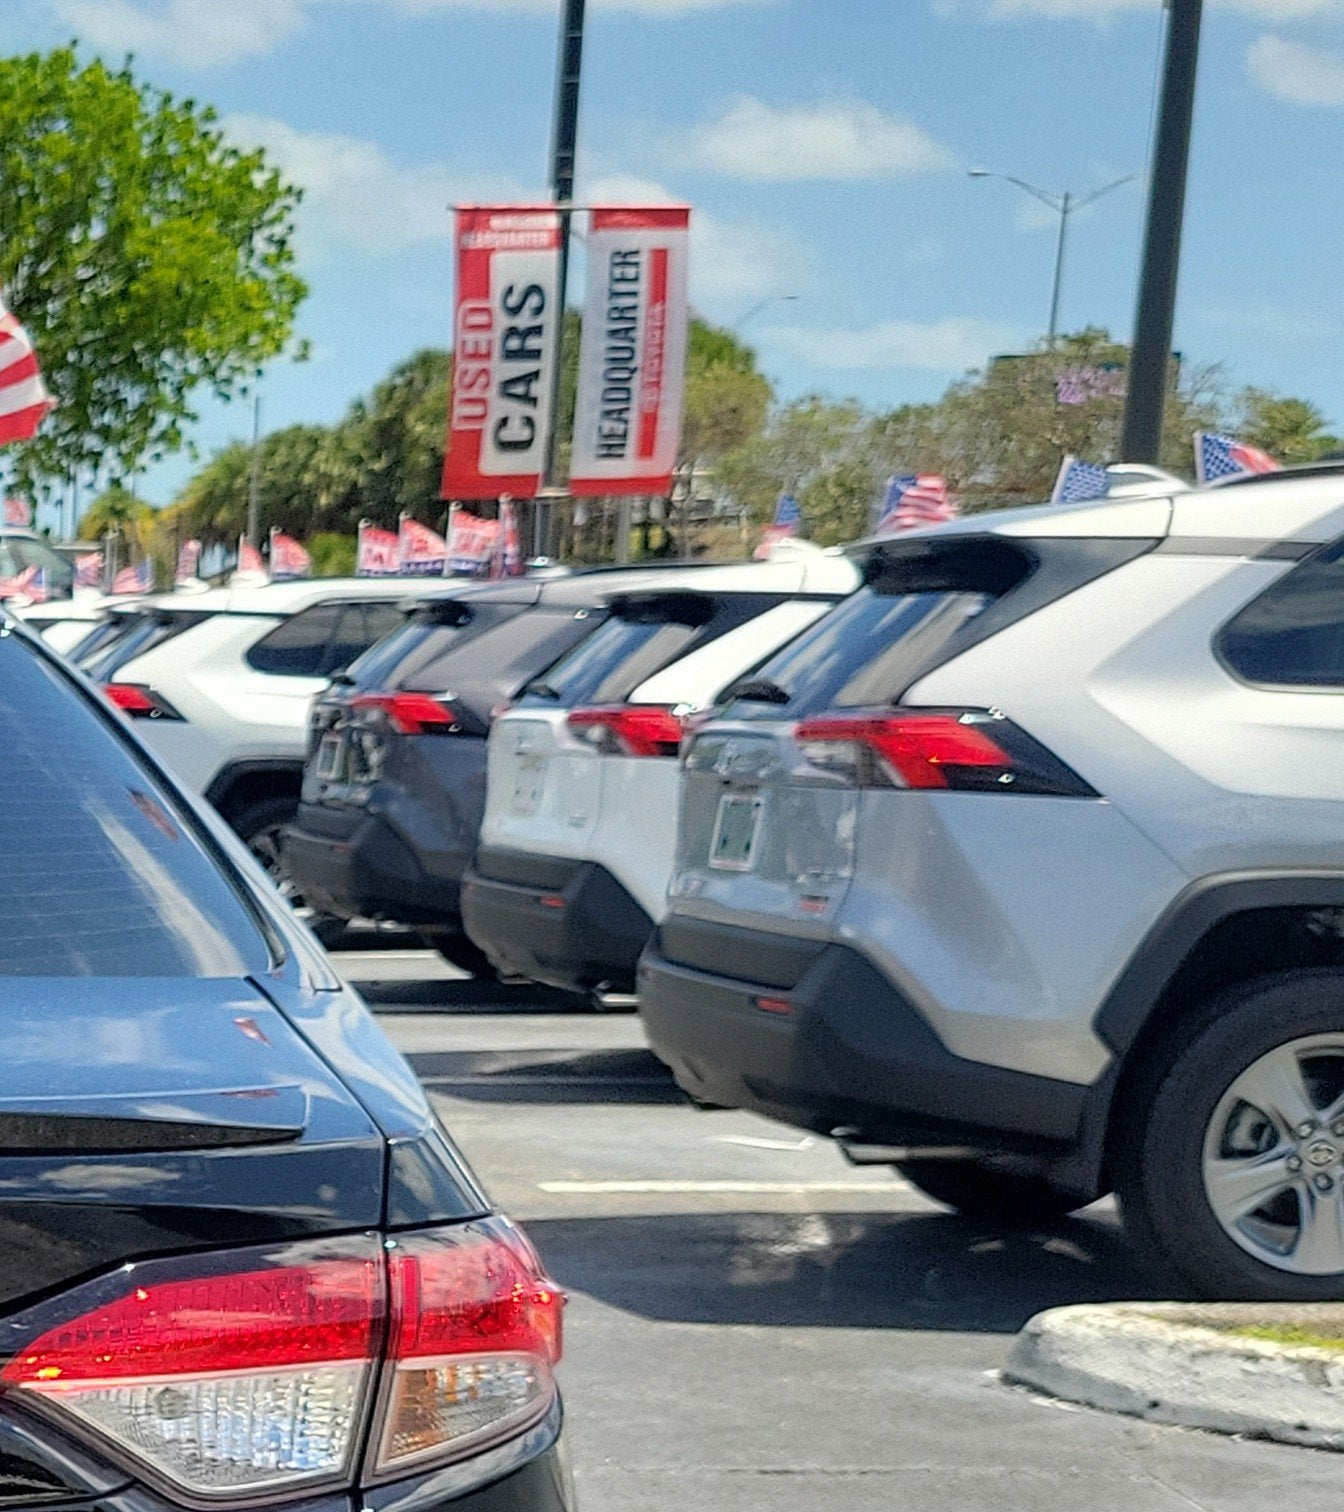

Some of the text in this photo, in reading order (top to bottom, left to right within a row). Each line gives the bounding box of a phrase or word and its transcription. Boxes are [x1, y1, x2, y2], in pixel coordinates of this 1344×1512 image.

[458, 305, 493, 424] USED
[493, 282, 546, 453] CARS
[596, 248, 641, 460] HEADQUARTER
